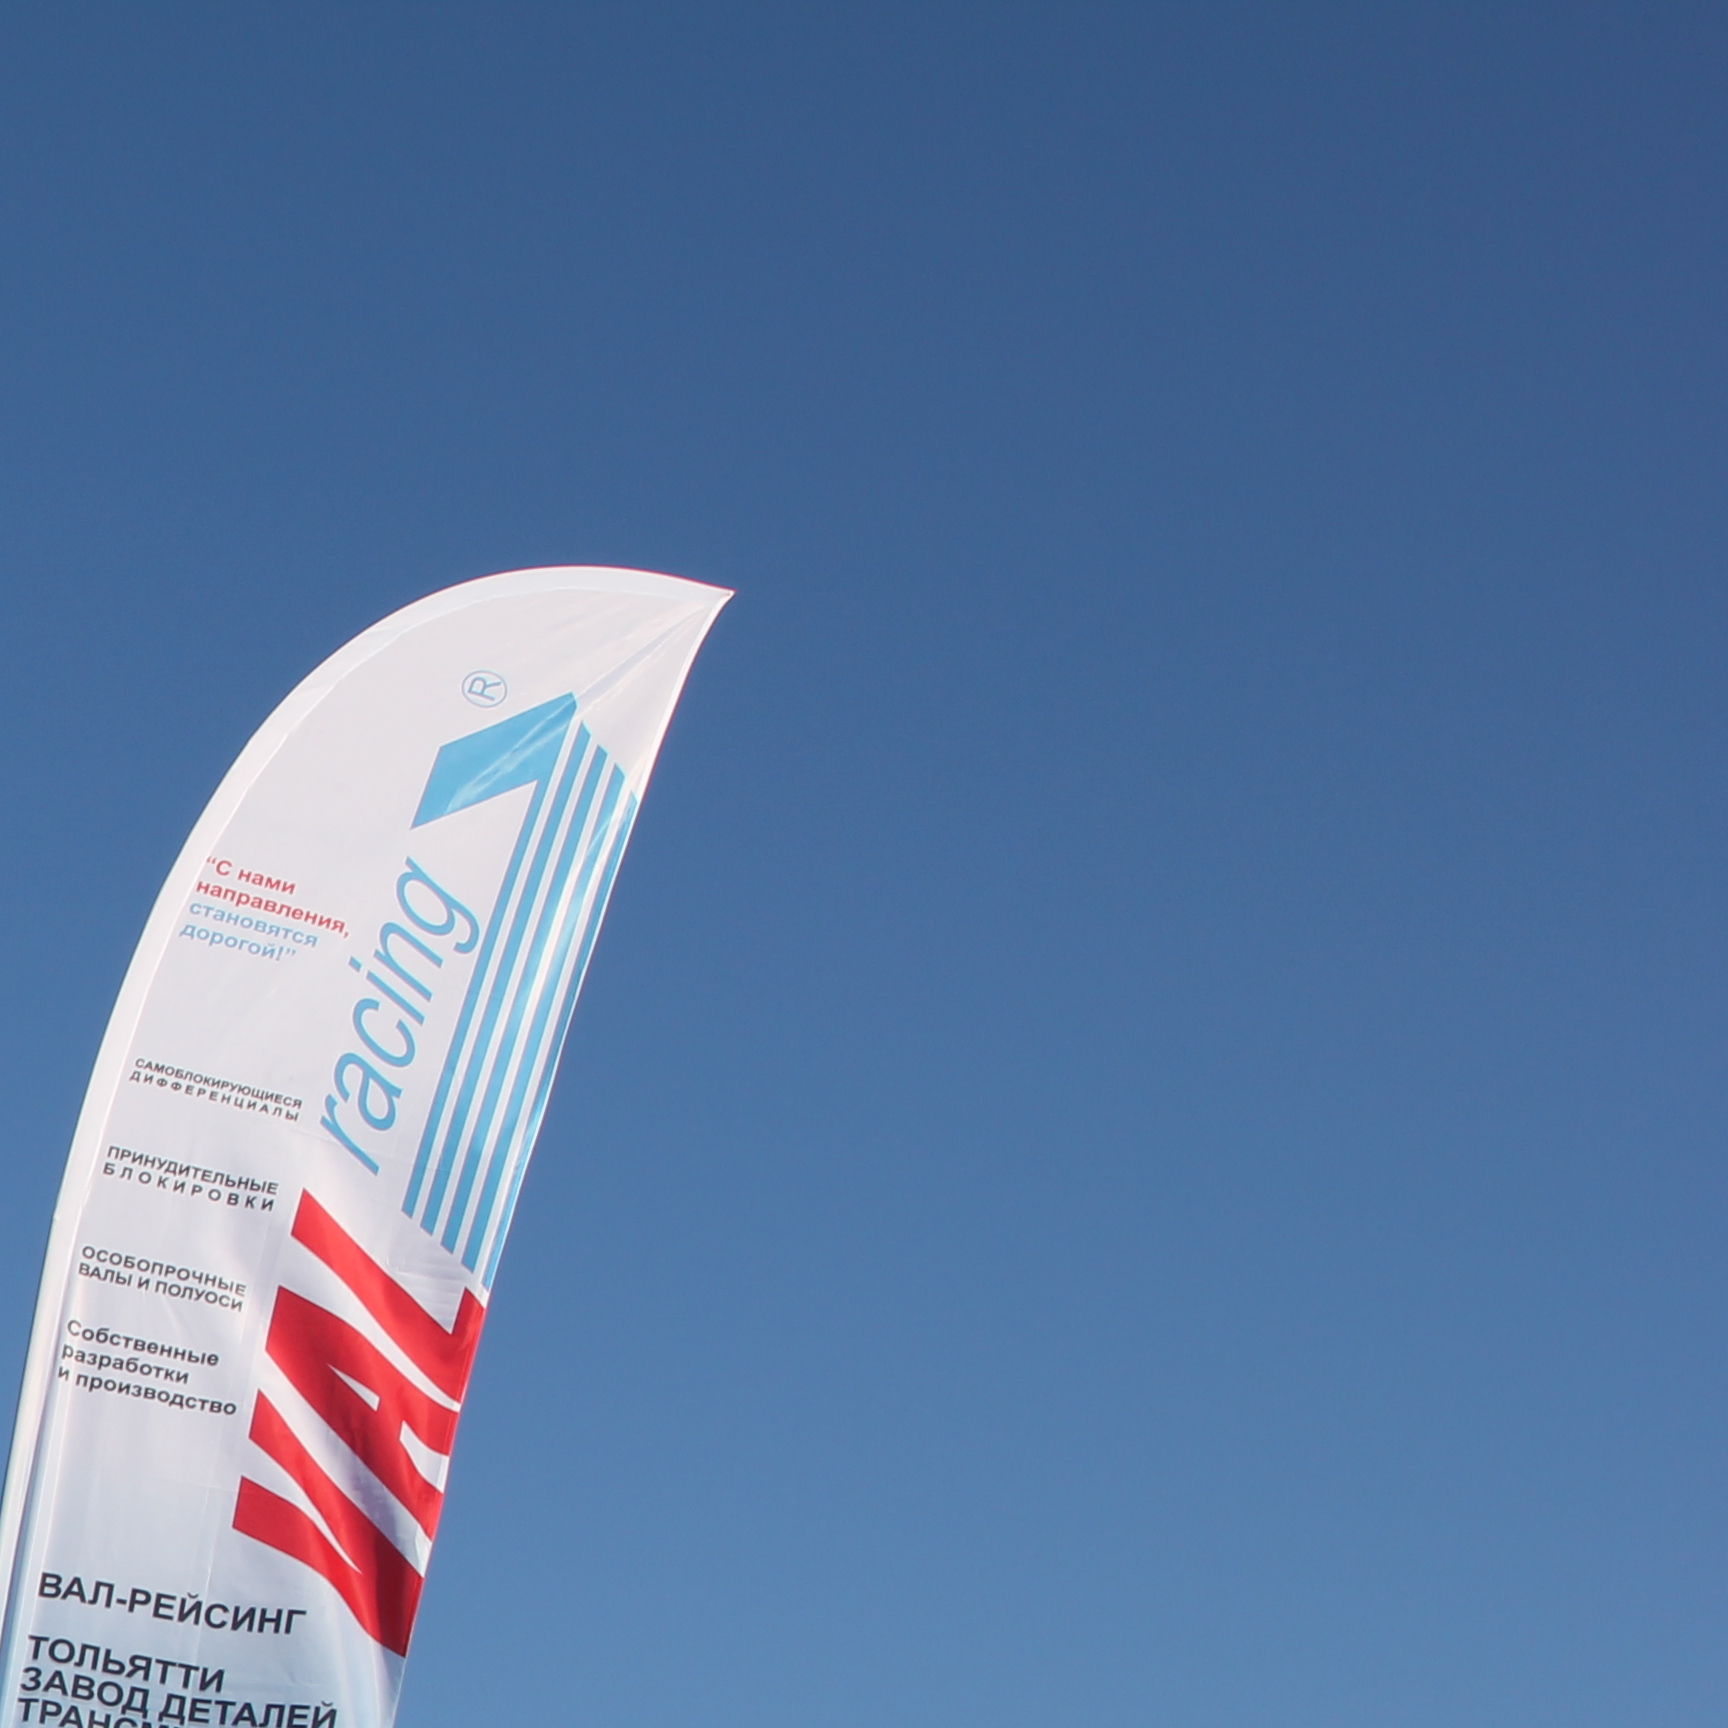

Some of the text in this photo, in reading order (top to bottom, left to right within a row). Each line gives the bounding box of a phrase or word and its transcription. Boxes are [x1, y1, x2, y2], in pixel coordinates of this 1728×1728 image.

[237, 869, 296, 895] нами
[189, 903, 318, 948] становятся
[196, 881, 350, 938] направления,
[319, 856, 481, 1176] racing
[129, 1070, 300, 1121] ДИФФЕРЕНЦИАЛЫ
[135, 1058, 302, 1109] САМОБЛОКИРУЮЩИЕСЯ
[103, 1162, 275, 1212] БЛОКИРОВКИ
[107, 1145, 279, 1195] ПРИНУДИТЕЛЬНЫЕ
[78, 1262, 243, 1312] ВАЛЫ И ПОЛУОСИ
[82, 1246, 247, 1297] ОСОБОПРОЧНЫЕ
[62, 1344, 190, 1385] разработки
[67, 1319, 219, 1366] Собственные
[58, 1366, 237, 1415] и производство
[232, 1187, 487, 1658] VAL
[38, 1572, 307, 1635] ВАЛ-РЕЙСИНГ
[28, 1634, 226, 1693] ТОЛЬЯТТИ
[20, 1666, 150, 1716] ЗАВОД
